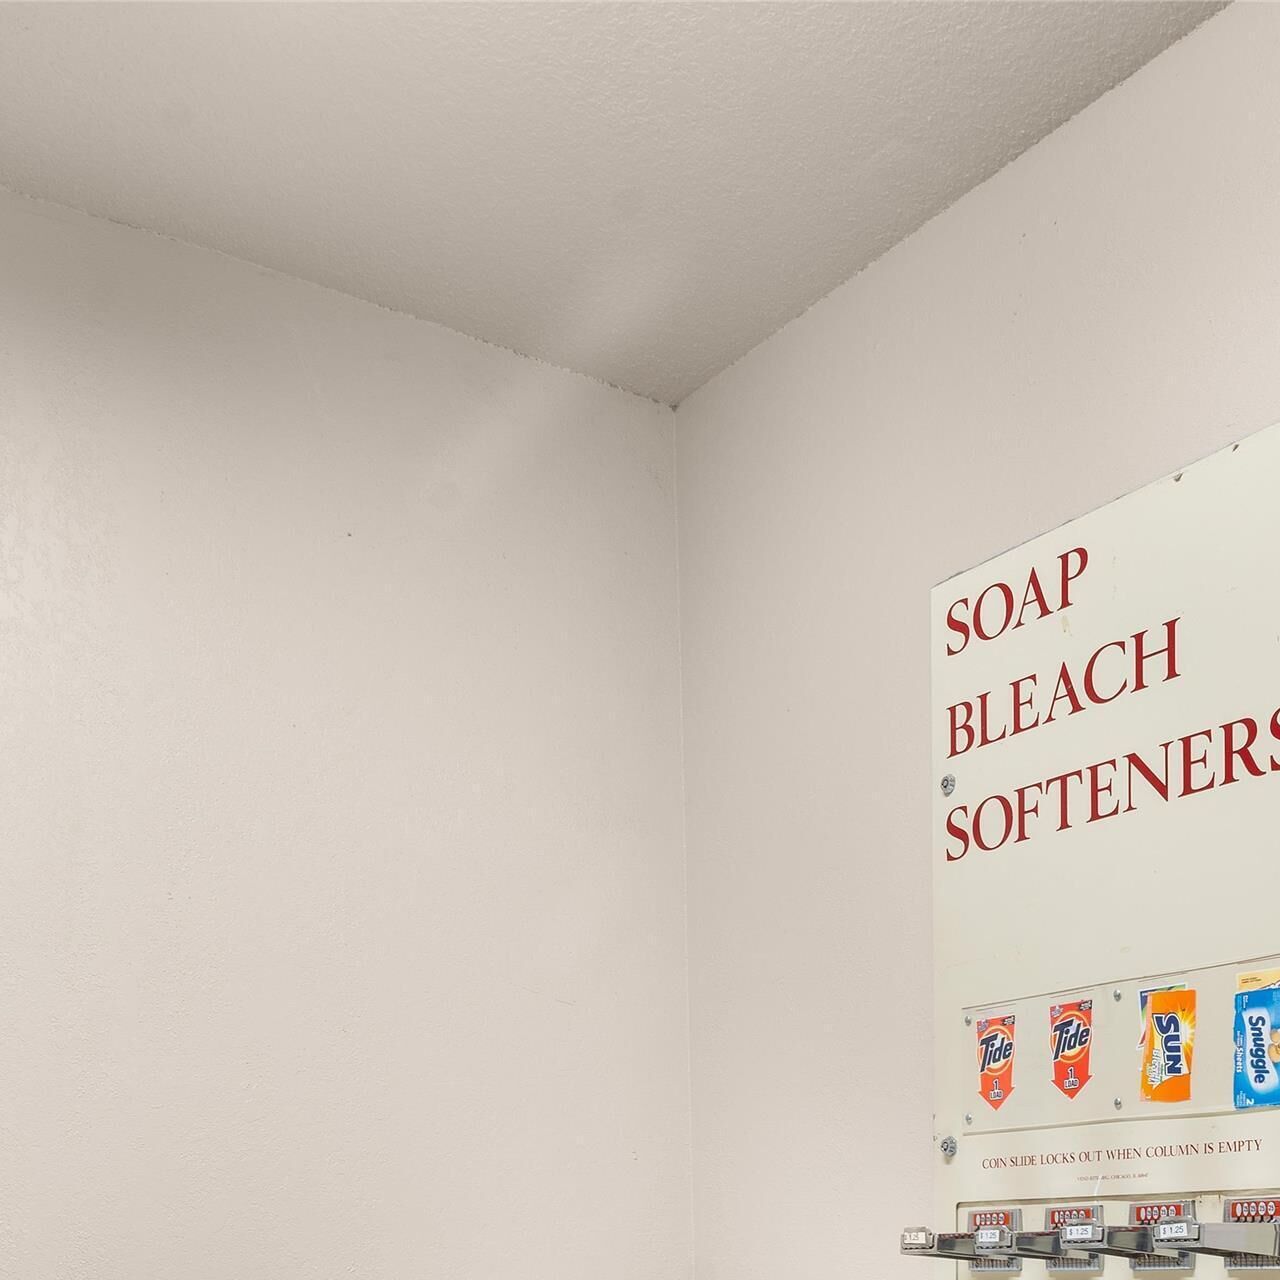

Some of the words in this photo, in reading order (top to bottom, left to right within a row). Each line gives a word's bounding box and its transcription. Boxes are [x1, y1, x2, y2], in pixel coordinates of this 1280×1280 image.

[945, 546, 1089, 657] SOAP
[945, 616, 1182, 760] BLEACH
[979, 1032, 1013, 1073] Tide
[1052, 1018, 1091, 1061] Tide
[1152, 1012, 1182, 1076] SUN
[1248, 1015, 1270, 1084] Snuggle
[982, 1157, 1008, 1169] COIN
[1009, 1155, 1037, 1167] SLIDE
[1040, 1152, 1076, 1166] LOCKS
[1078, 1150, 1102, 1162] OUT
[1106, 1147, 1142, 1161] WHEN
[1145, 1143, 1200, 1158] COLUMN
[1203, 1142, 1214, 1155] IS
[1218, 1139, 1262, 1154] EMPTY
